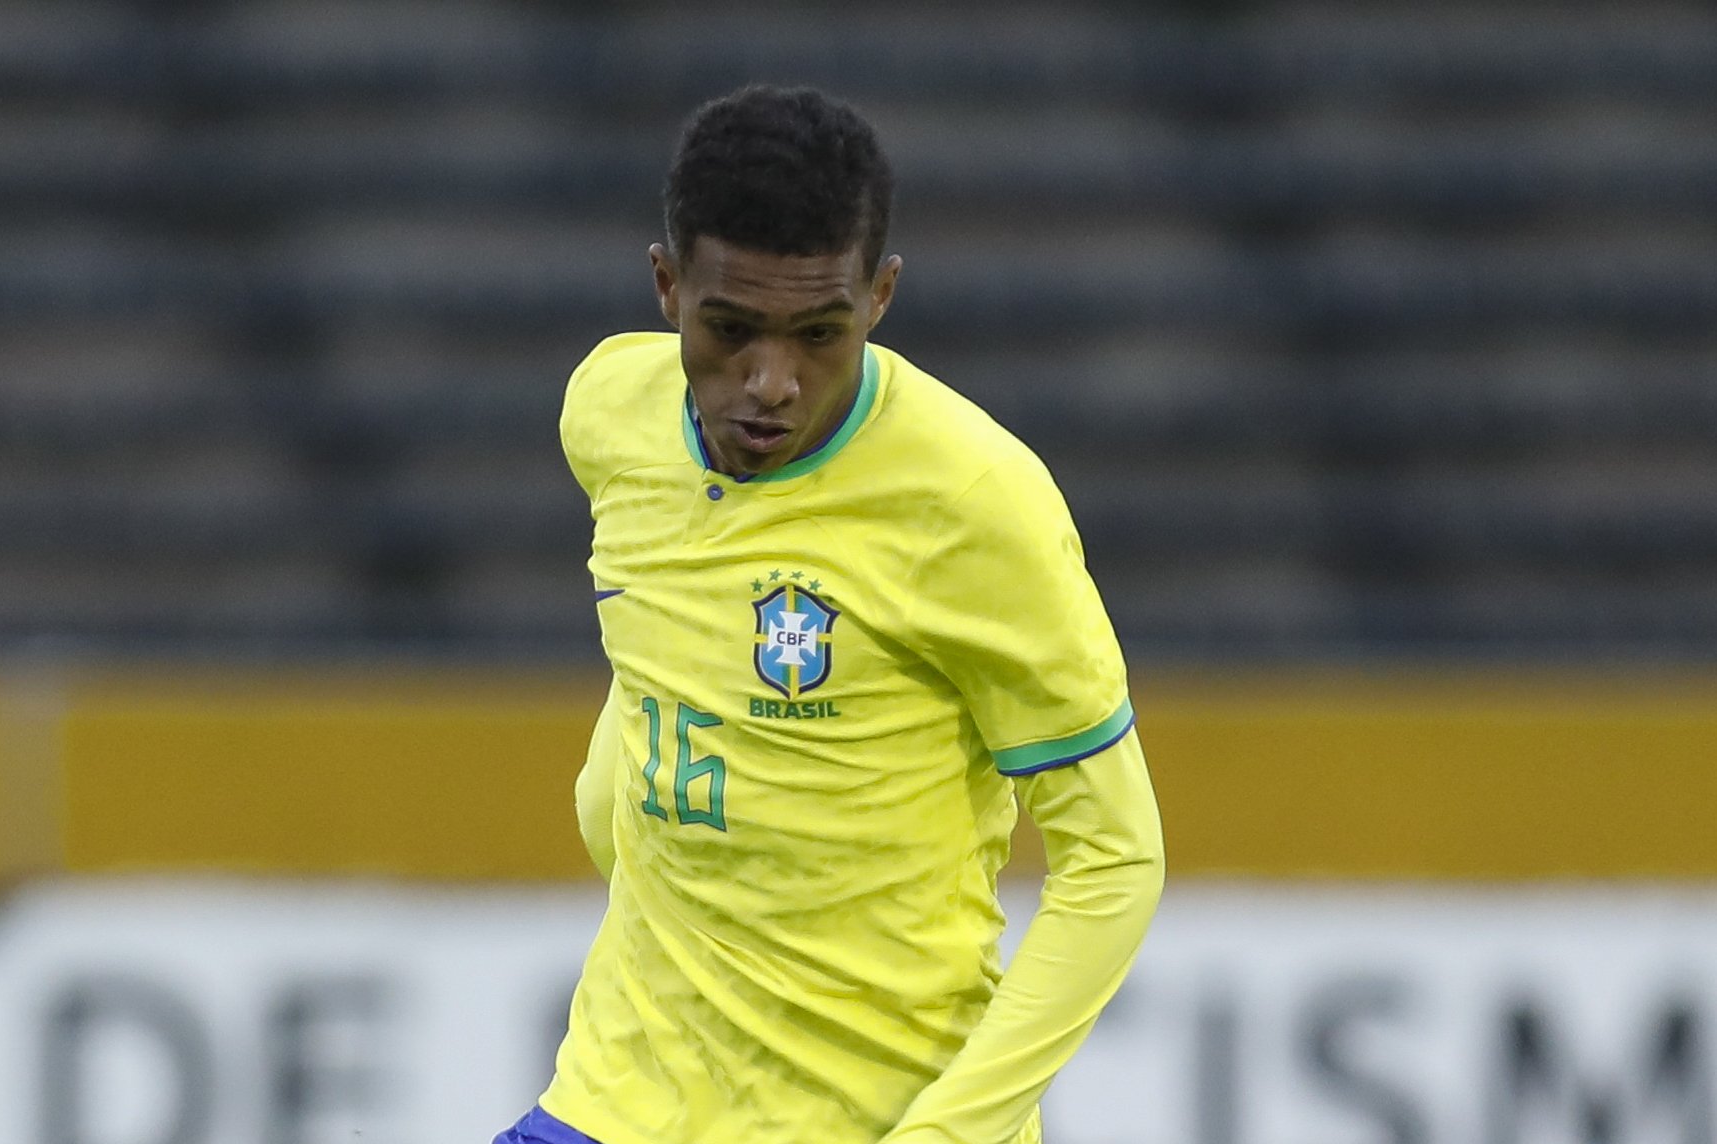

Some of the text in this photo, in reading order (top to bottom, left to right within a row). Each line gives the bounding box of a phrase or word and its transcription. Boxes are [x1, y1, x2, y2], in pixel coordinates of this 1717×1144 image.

[776, 631, 808, 647] CBF
[749, 697, 841, 720] BRASIL
[641, 696, 727, 833] 16
